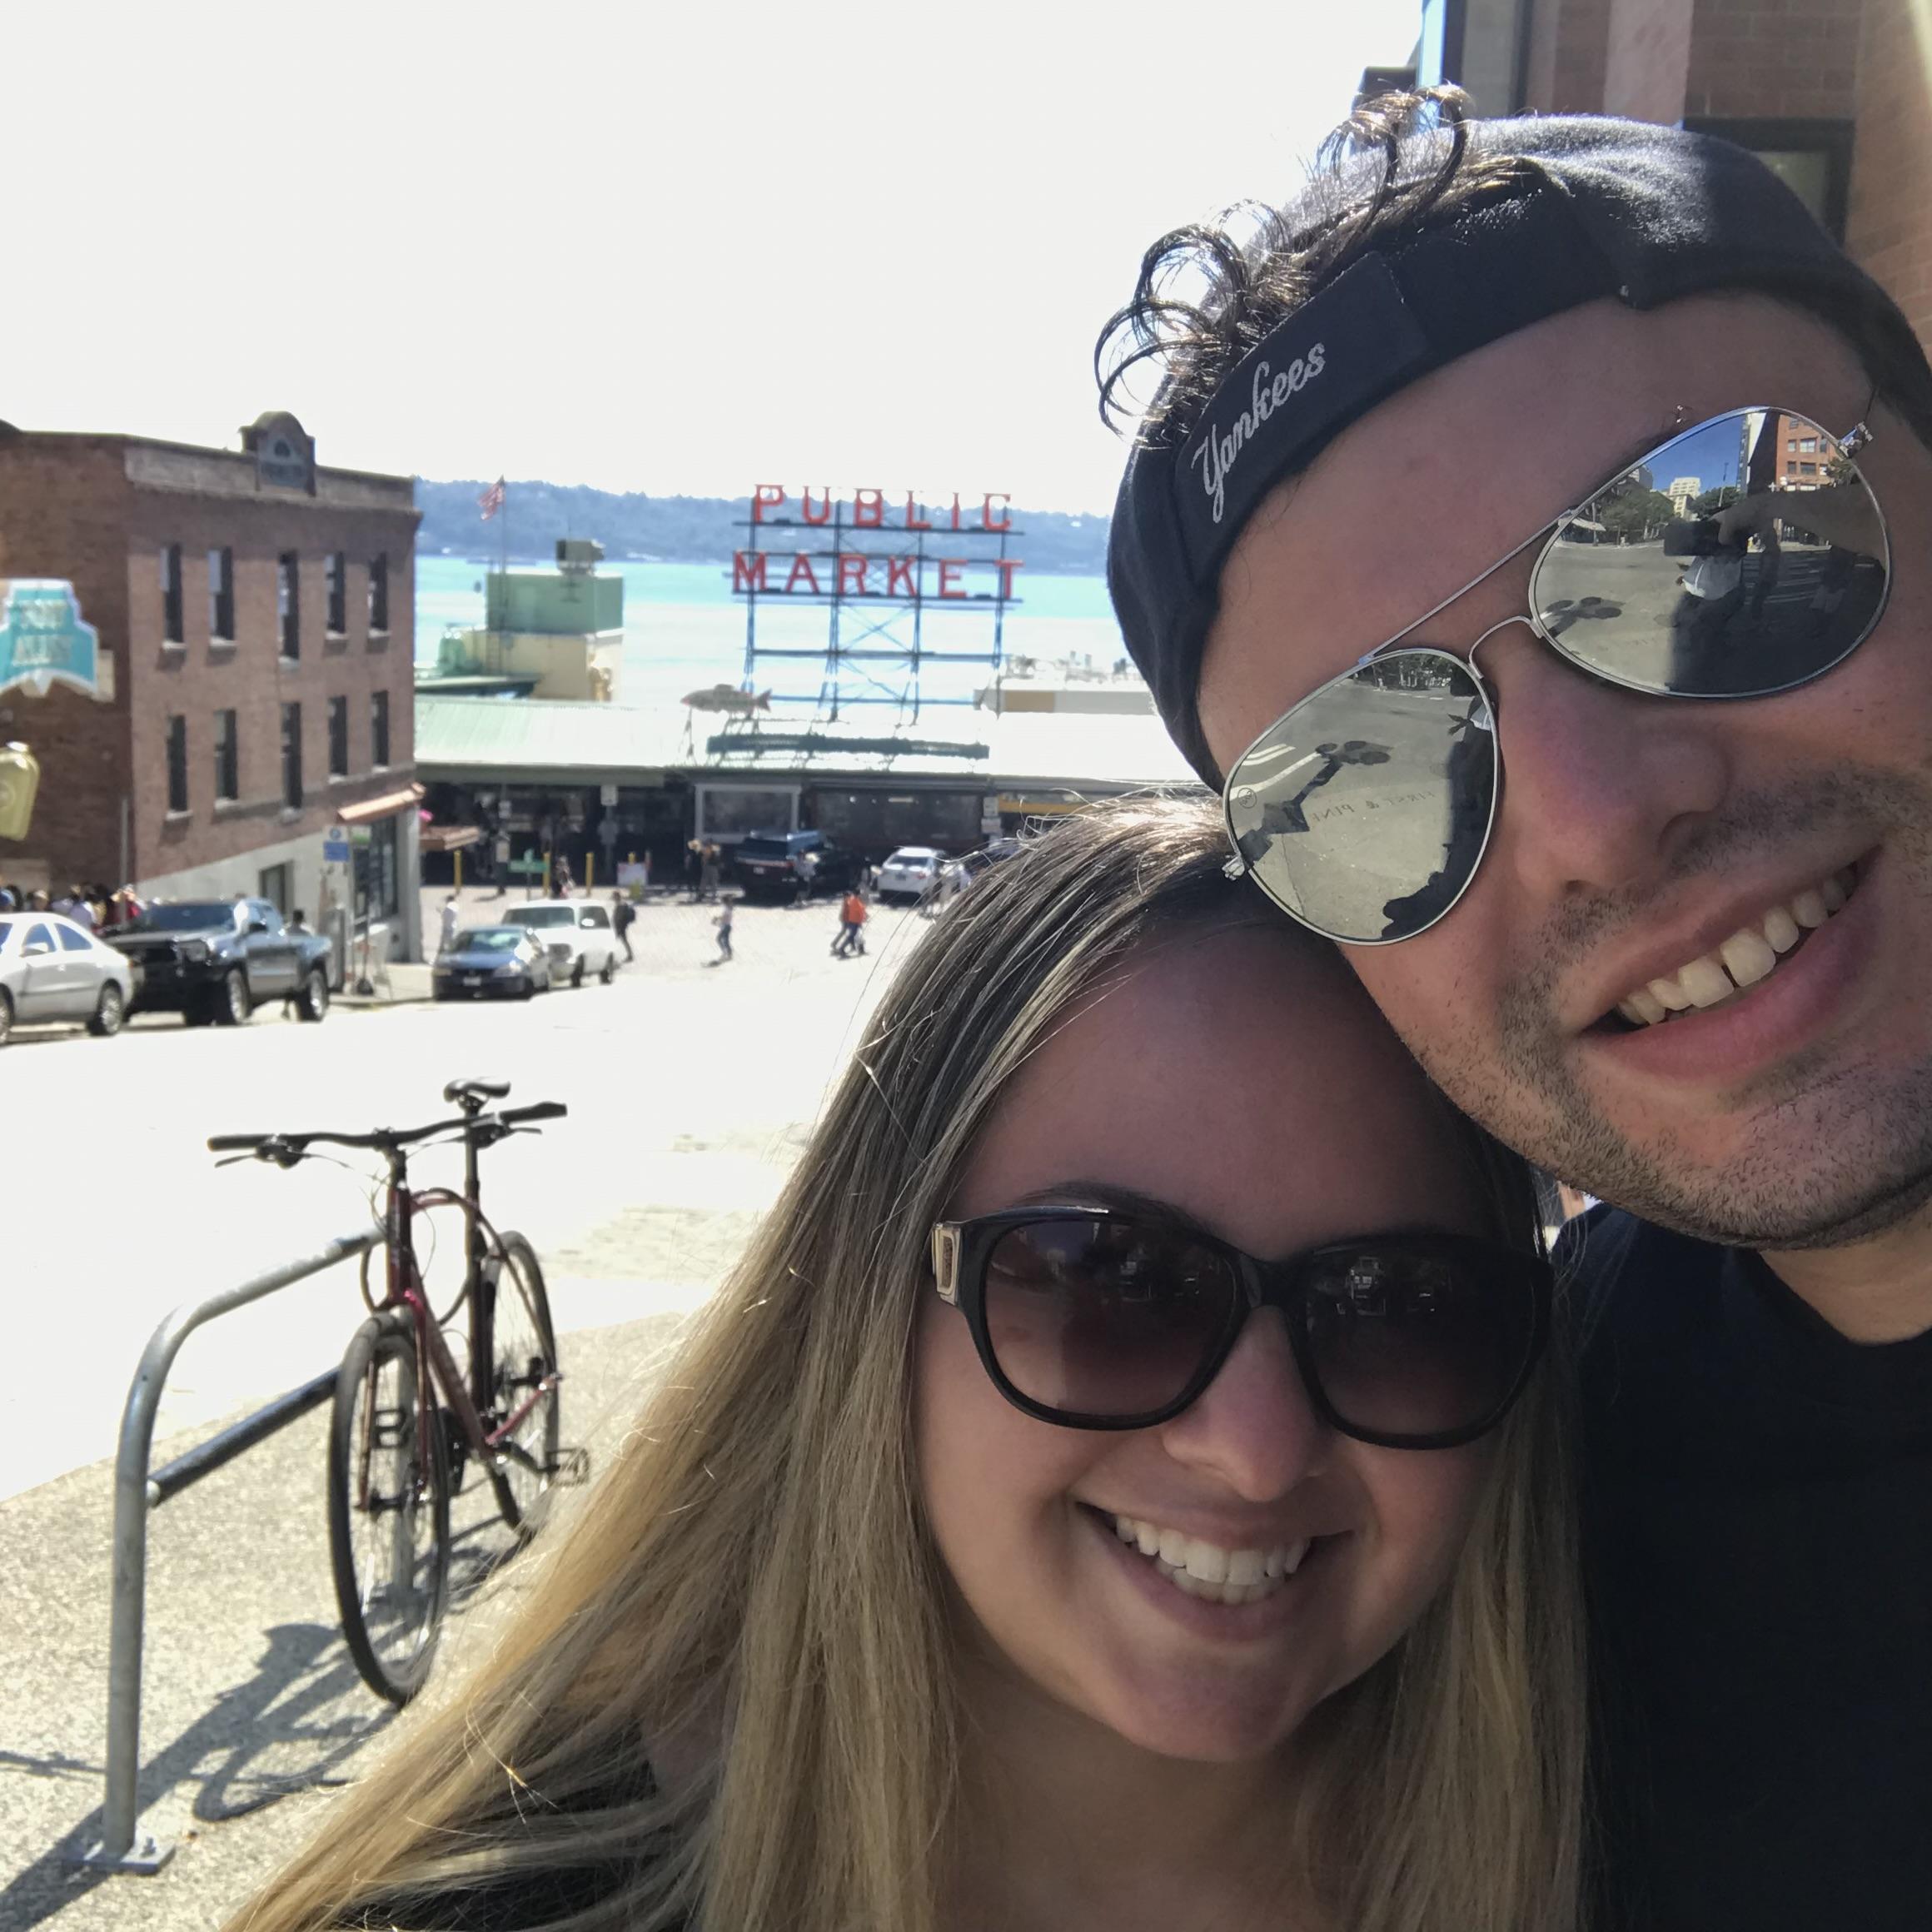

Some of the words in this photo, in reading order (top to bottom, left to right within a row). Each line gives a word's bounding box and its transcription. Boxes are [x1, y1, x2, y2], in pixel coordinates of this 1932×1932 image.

[1190, 342, 1327, 524] Yankees
[754, 484, 1012, 530] PUBLIC
[731, 549, 1025, 599] MARKET
